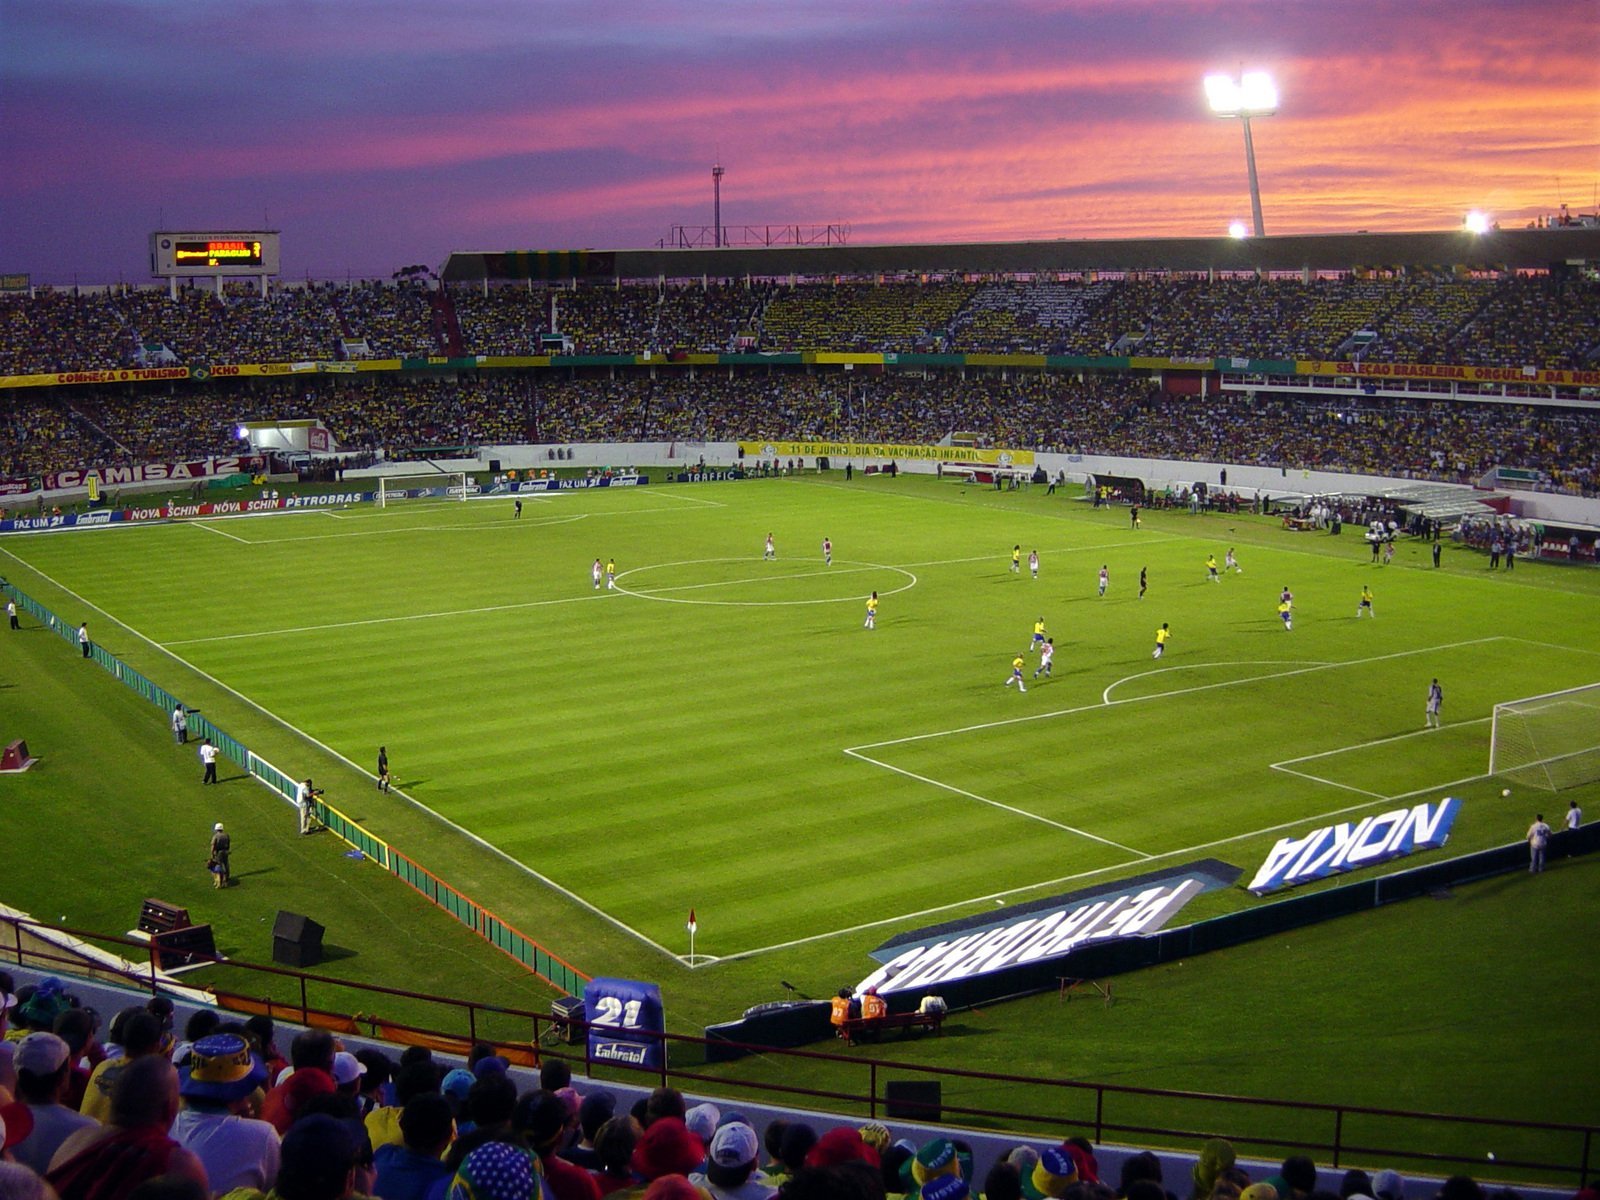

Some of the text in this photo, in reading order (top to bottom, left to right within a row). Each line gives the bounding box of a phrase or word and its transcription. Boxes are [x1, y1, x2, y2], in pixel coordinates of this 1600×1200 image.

[120, 371, 129, 380] O
[132, 368, 187, 380] TURISMO
[1545, 371, 1565, 382] DA
[804, 445, 816, 455] DE
[855, 446, 870, 455] DIA
[57, 458, 240, 488] CAMISA 12
[687, 471, 735, 482] TRAFFIC
[559, 480, 573, 489] FAZ
[588, 477, 601, 487] 21
[212, 499, 279, 513] NOVA SCHIN
[286, 493, 361, 508] PETROBRAS
[131, 505, 200, 520] NOVA SCHIN
[14, 516, 65, 529] FAZ UM 21
[76, 515, 111, 524] Embratel
[1248, 797, 1451, 889] NOKIA
[852, 879, 1200, 998] PETROBRAS
[591, 997, 642, 1029] 21
